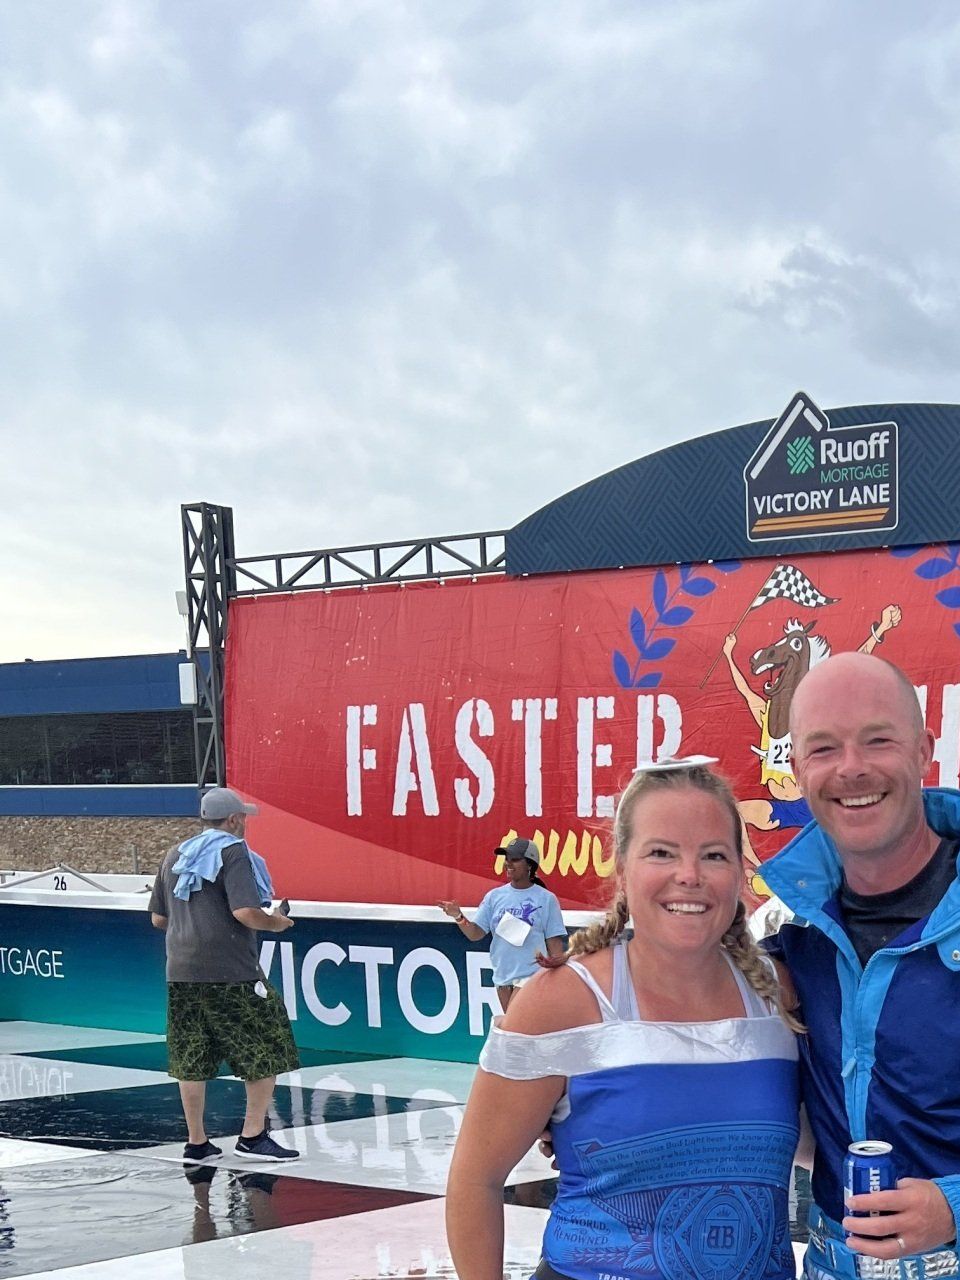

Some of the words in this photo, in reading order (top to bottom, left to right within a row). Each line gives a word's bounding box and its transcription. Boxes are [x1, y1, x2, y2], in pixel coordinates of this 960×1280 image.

[820, 431, 890, 464] Ruoff
[820, 463, 890, 484] MORTGAGE
[753, 488, 834, 515] VICTORY
[839, 483, 890, 507] LANE
[54, 876, 67, 890] 26
